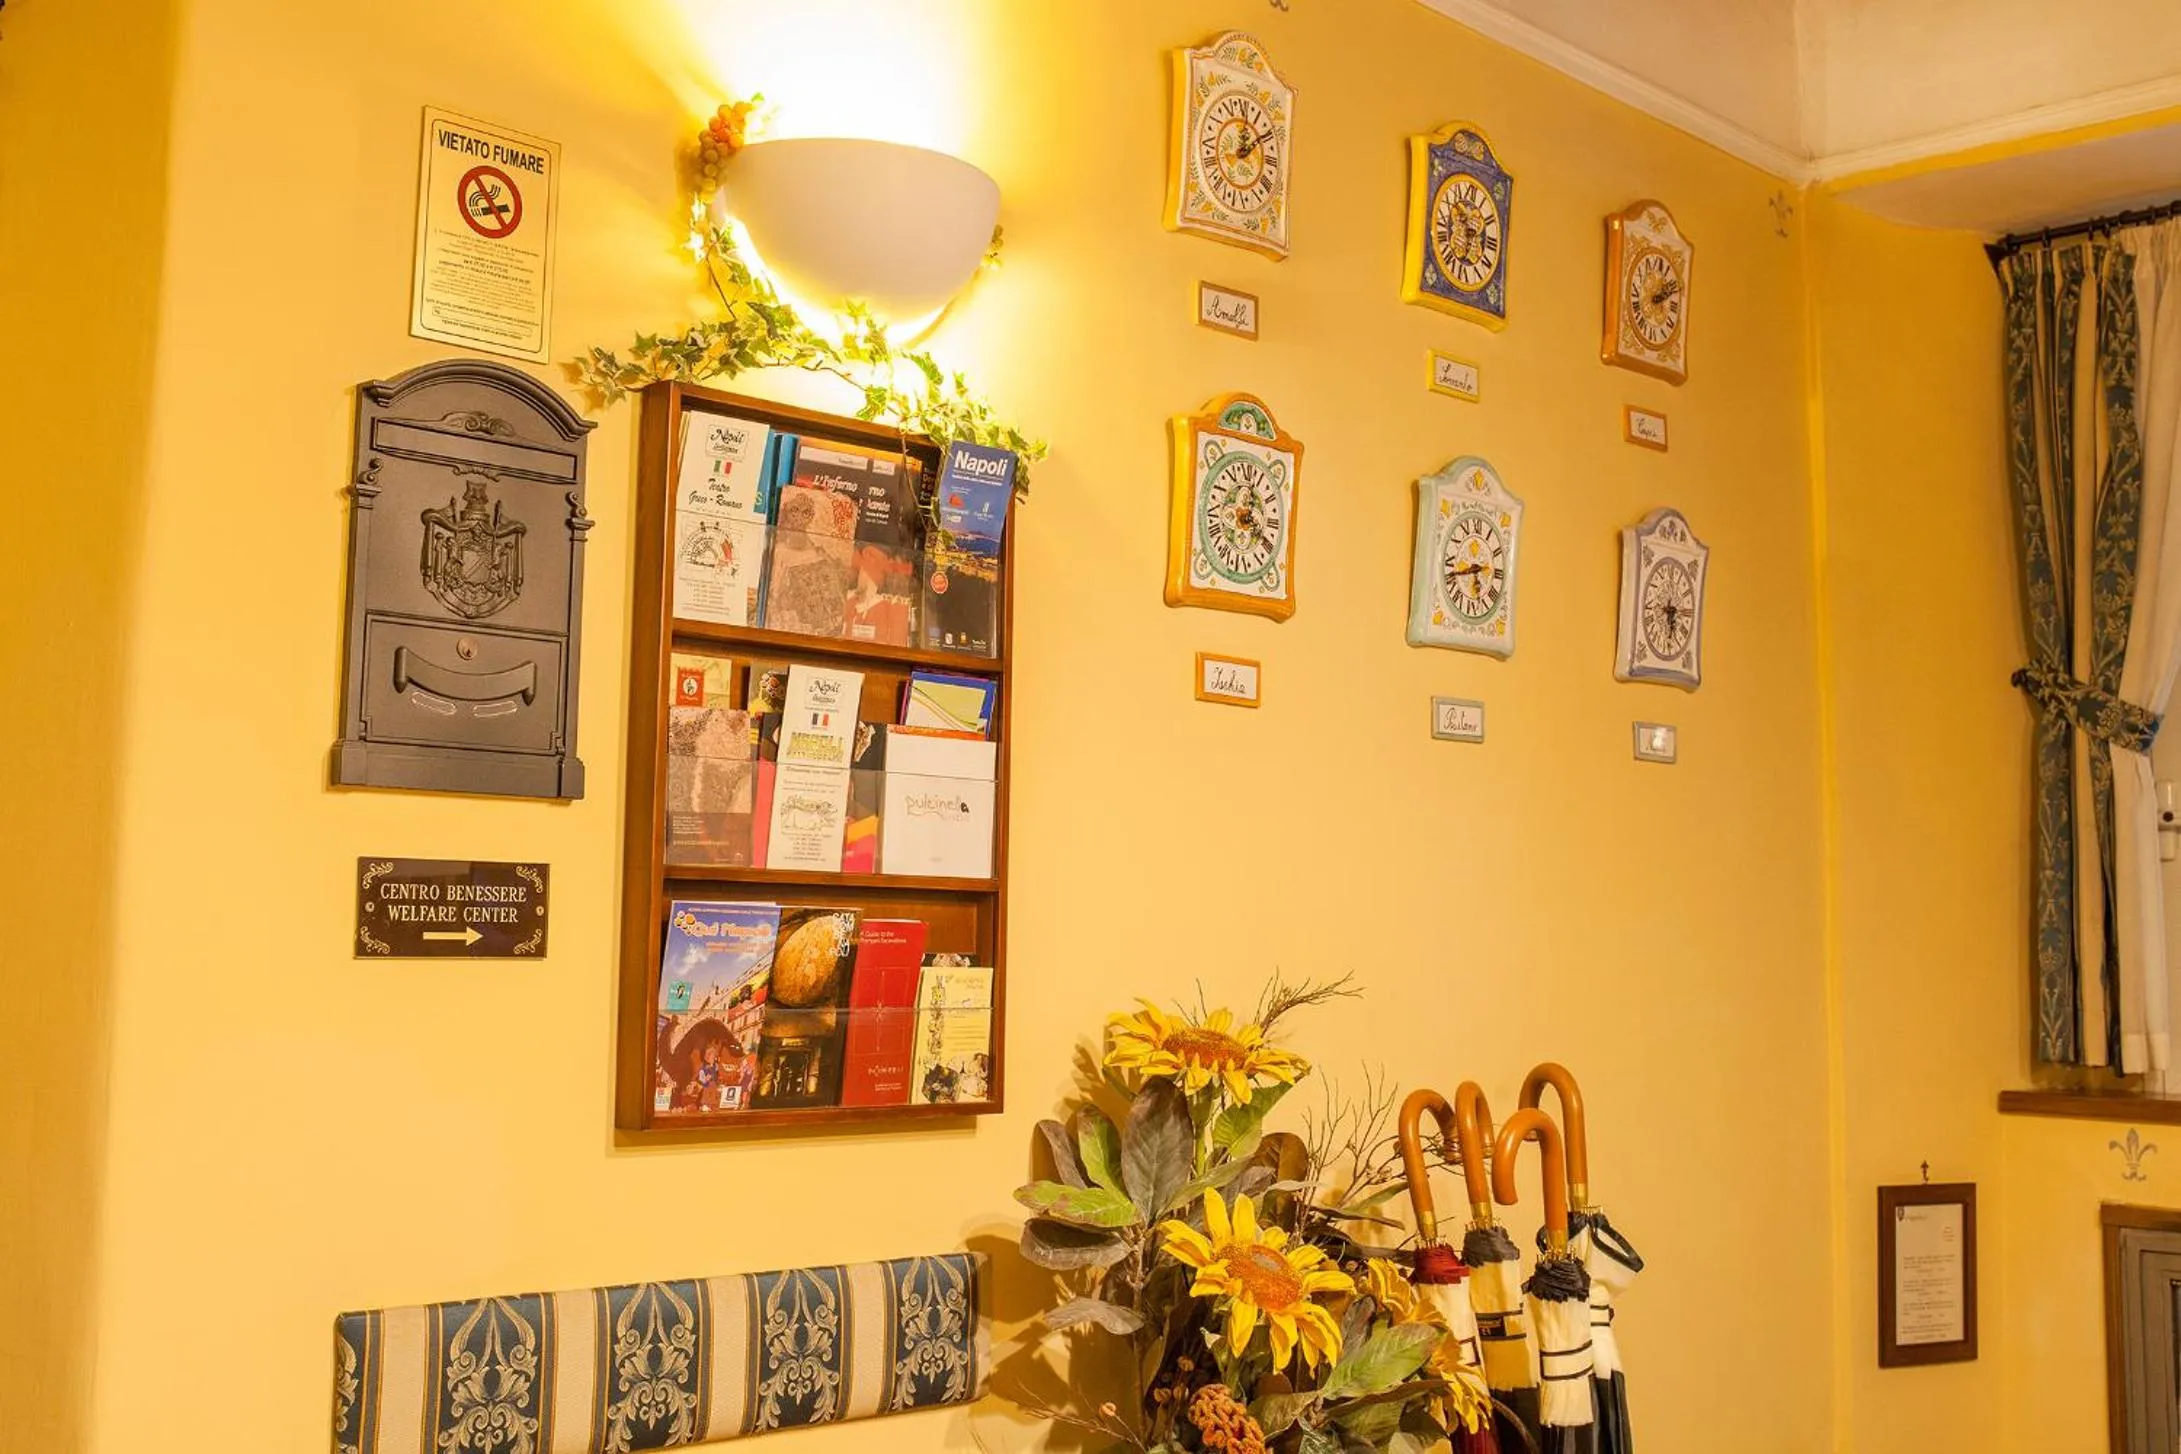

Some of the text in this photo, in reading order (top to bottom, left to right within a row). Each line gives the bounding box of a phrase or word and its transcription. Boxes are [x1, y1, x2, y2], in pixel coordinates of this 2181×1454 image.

[438, 129, 545, 175] VIETATO FUMARE
[953, 450, 1008, 477] Napoli
[380, 883, 527, 904] CENTRO BENESSERE
[388, 904, 519, 924] WELFARE CENTER
